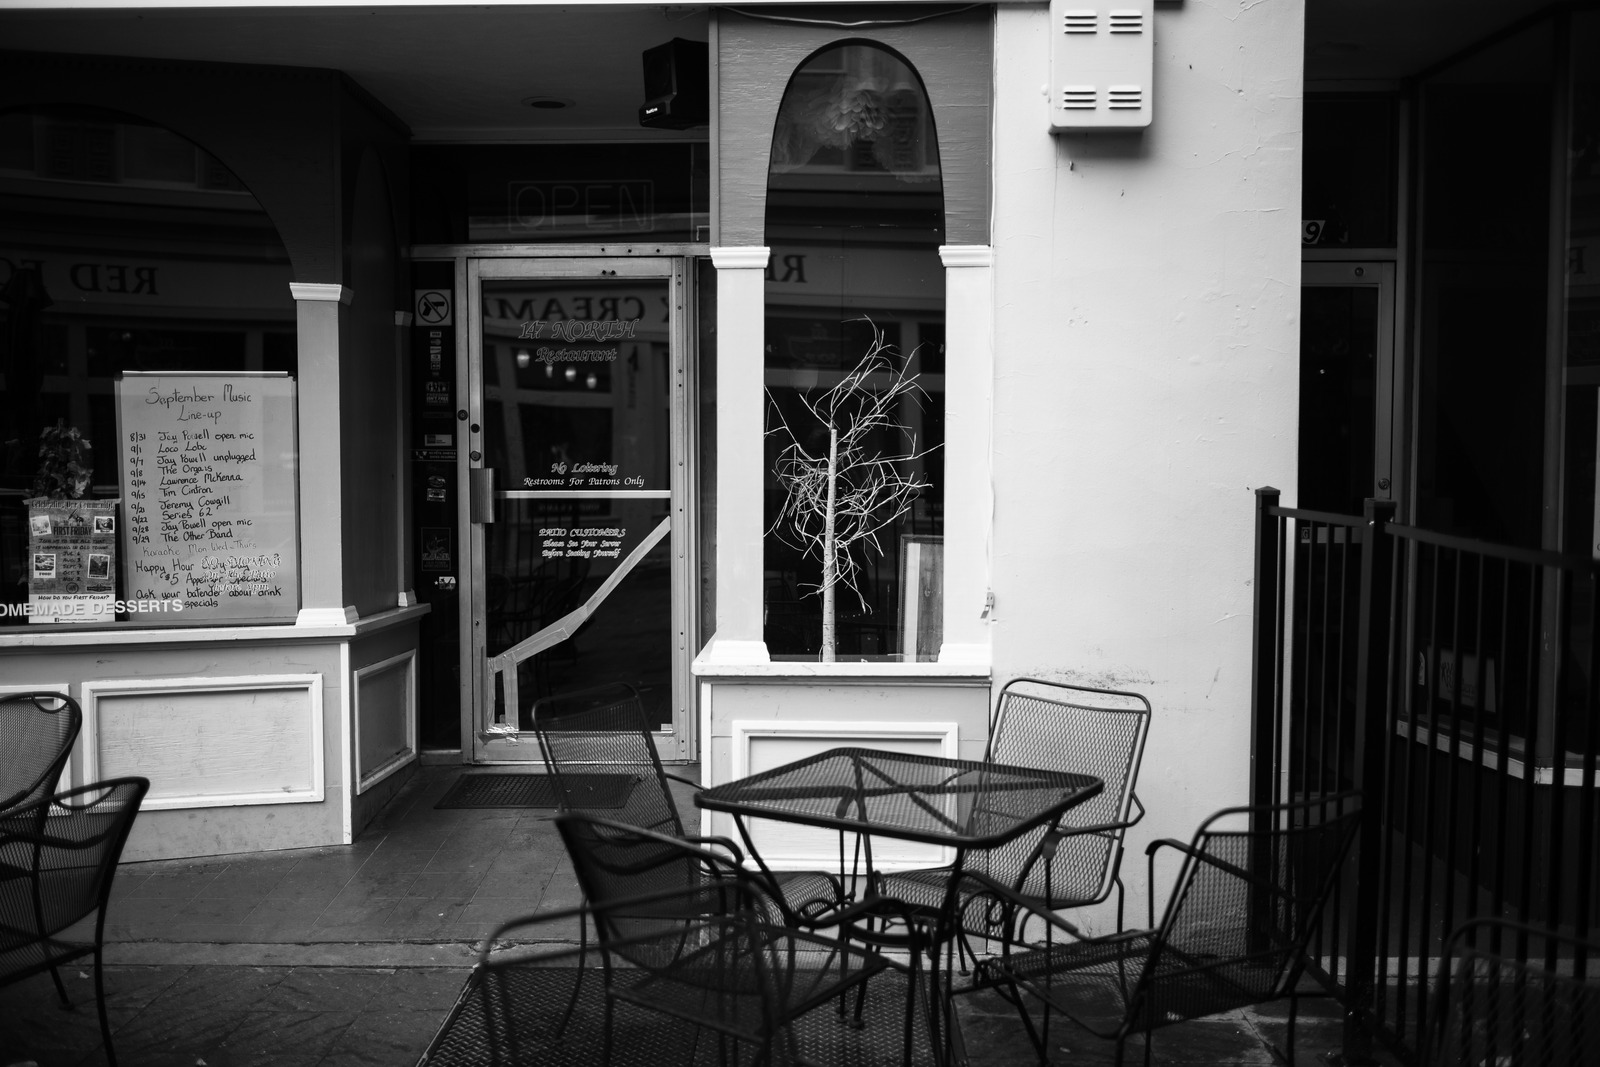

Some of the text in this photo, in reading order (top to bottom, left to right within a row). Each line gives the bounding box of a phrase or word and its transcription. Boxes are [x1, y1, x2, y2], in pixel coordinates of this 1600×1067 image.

[515, 184, 648, 229] OPEN
[518, 319, 640, 343] 147 NORTH
[535, 346, 618, 365] Restaurant
[145, 384, 252, 408] September Music
[177, 404, 222, 425] Line-up
[129, 431, 147, 443] 8/31
[215, 432, 236, 442] open
[239, 432, 255, 440] mic
[130, 444, 142, 455] 9/1
[158, 443, 179, 453] Loco
[157, 455, 177, 466] Jay
[180, 452, 207, 464] Powell
[213, 448, 256, 464] unplugged
[130, 468, 143, 478] 9/8
[157, 464, 177, 475] The
[550, 462, 619, 476] No Loitering
[160, 476, 199, 486] Lawrence
[523, 476, 646, 488] Restrooms For Patrons Only
[159, 487, 177, 497] Tim
[159, 500, 194, 511] Jeremy
[198, 496, 231, 510] Cowgill
[132, 507, 214, 524] 9/22 Series 62
[53, 526, 92, 536] FIRST FRIDAY
[161, 521, 179, 533] Jay
[178, 519, 207, 530] Powell
[212, 520, 232, 531] open
[236, 518, 253, 526] mic
[538, 528, 626, 538] PATIO CUSTOMERS
[133, 528, 234, 544] 9/29 The Other Band
[136, 560, 166, 575] Happy
[172, 558, 195, 572] Hour
[136, 588, 156, 600] Ask
[161, 591, 181, 601] your
[92, 599, 184, 614] DESSERTS
[184, 598, 219, 609] specials
